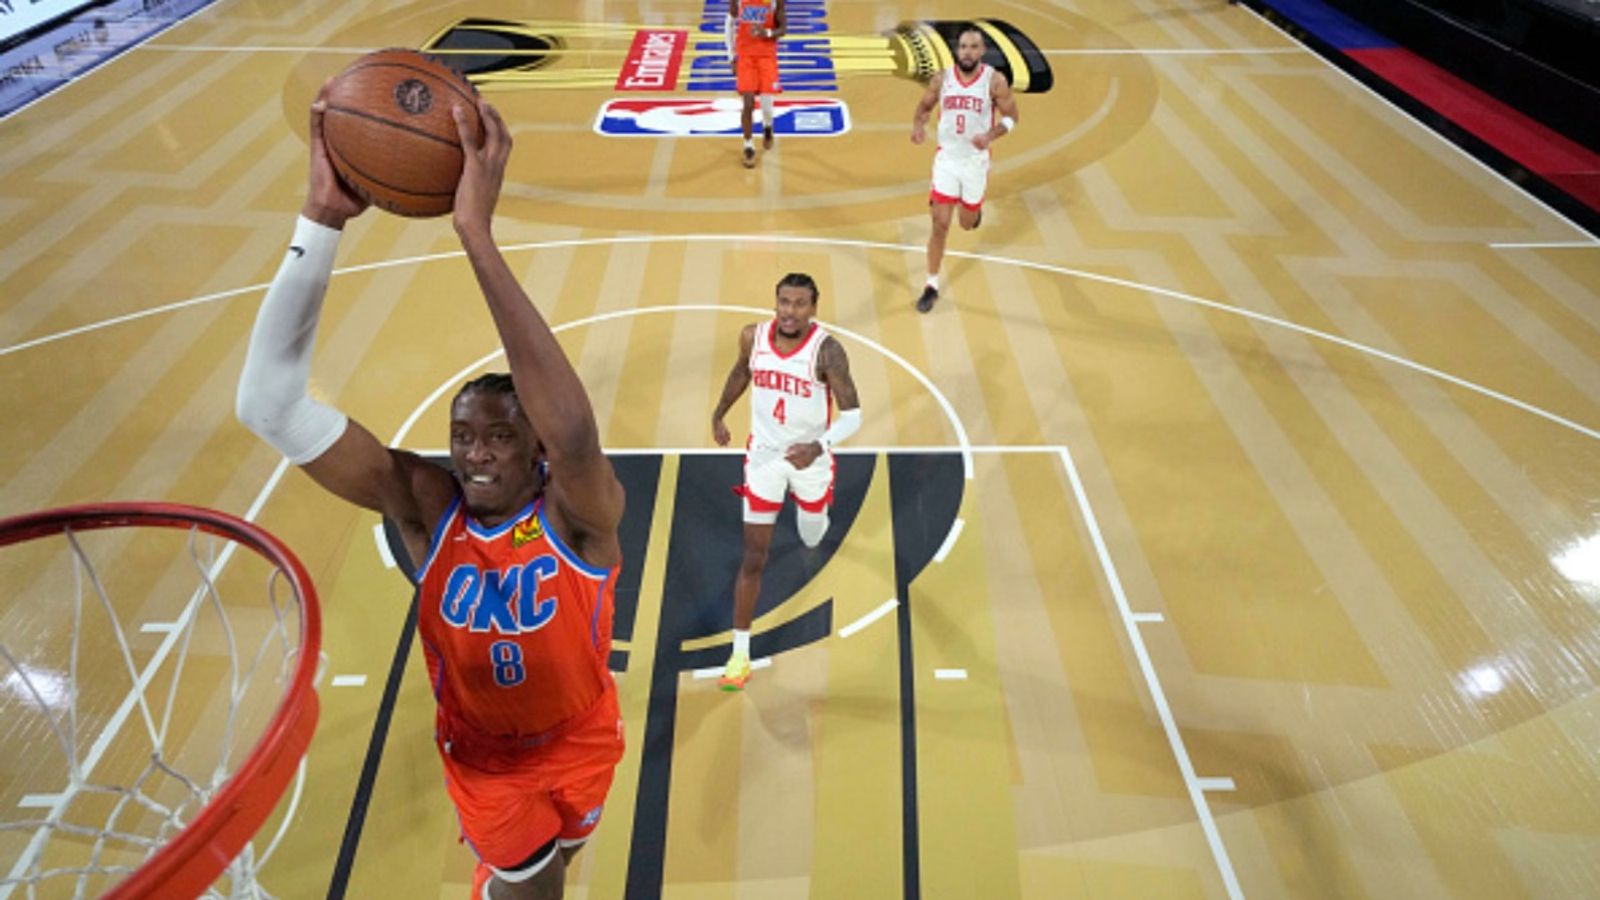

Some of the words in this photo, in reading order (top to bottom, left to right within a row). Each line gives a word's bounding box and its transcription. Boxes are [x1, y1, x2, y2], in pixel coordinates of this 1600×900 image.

[625, 33, 676, 86] Emirates
[943, 95, 984, 113] ROCKETS
[773, 397, 786, 425] 4
[440, 554, 559, 635] OKC
[490, 639, 527, 686] 8
